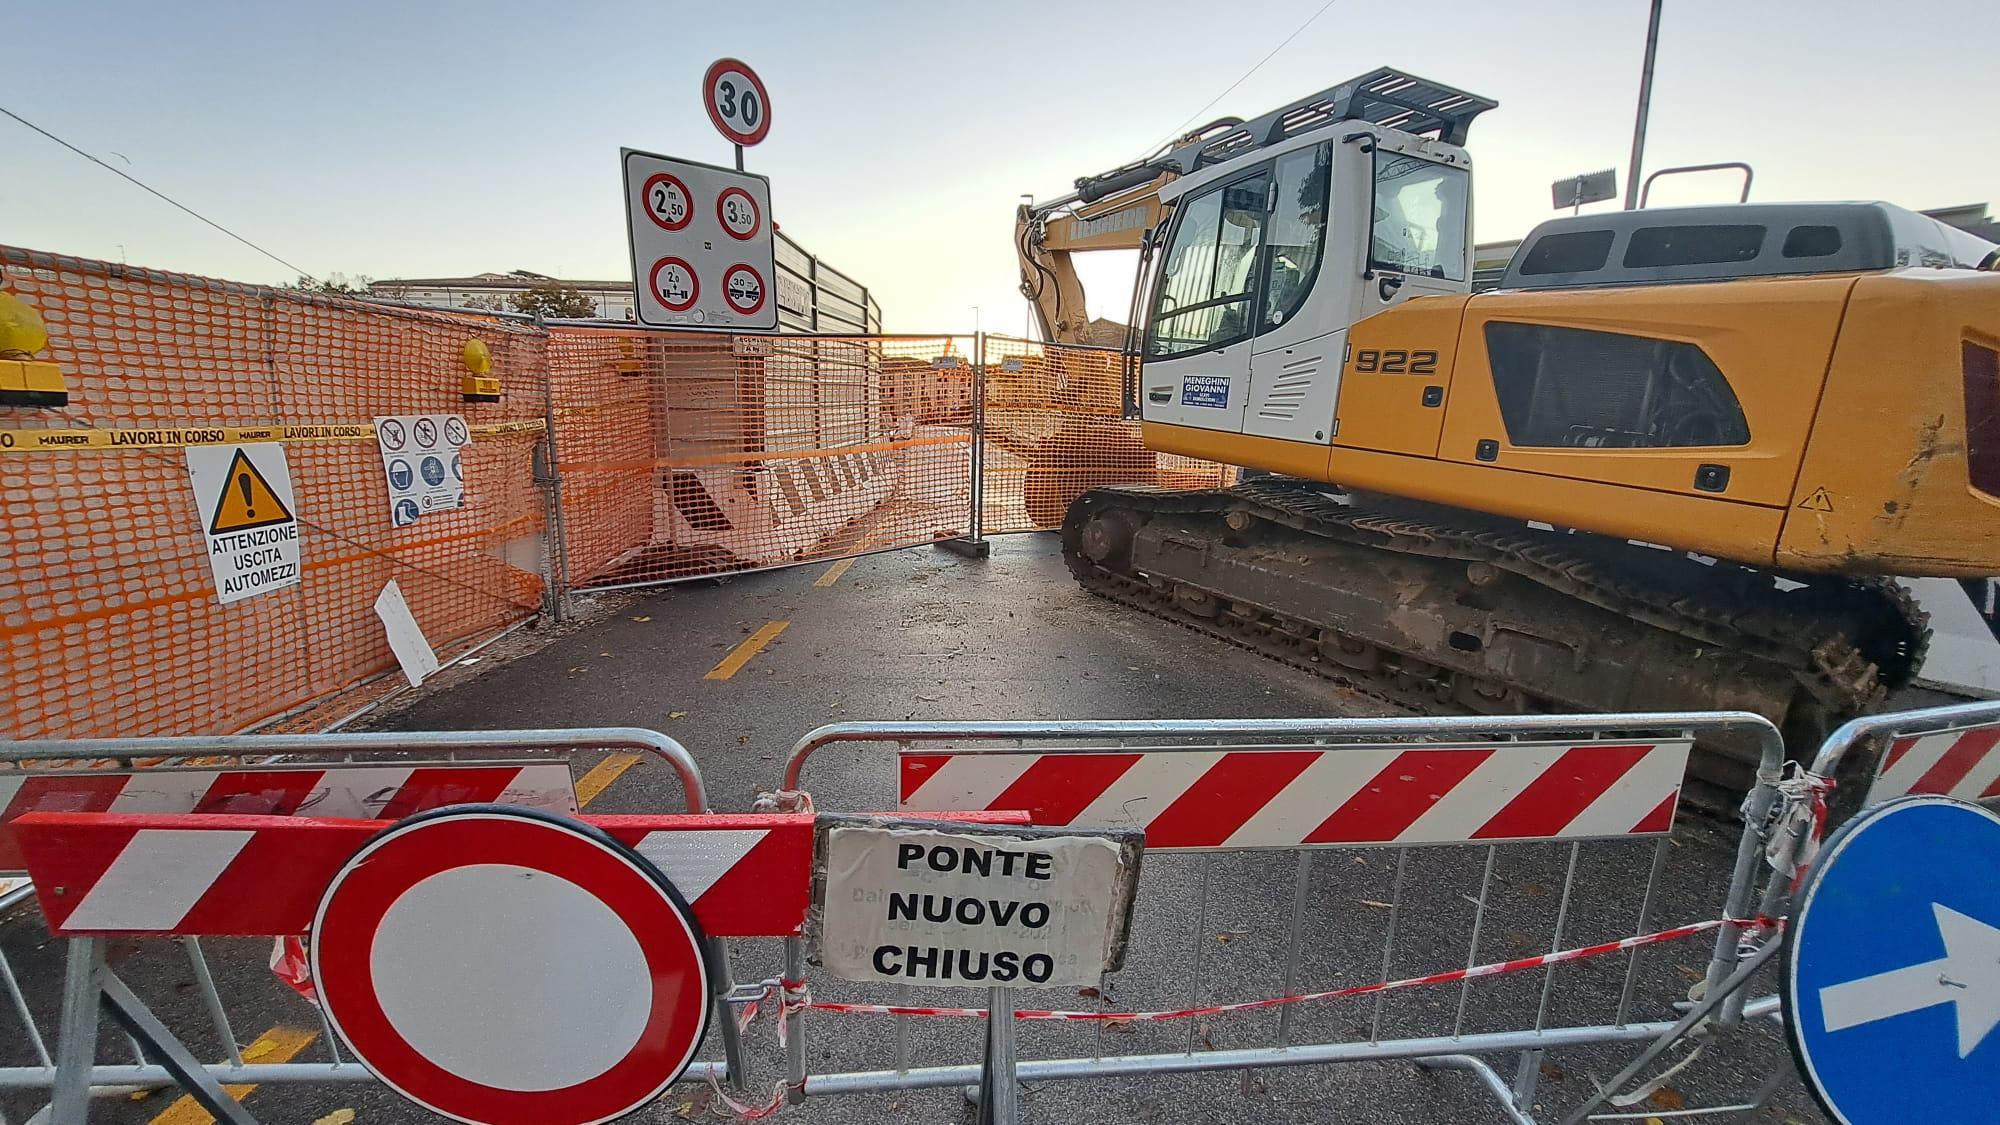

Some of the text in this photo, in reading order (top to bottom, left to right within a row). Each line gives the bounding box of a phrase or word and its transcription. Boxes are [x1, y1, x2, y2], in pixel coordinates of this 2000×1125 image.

[719, 80, 759, 127] 30
[733, 278, 745, 287] 30
[1355, 349, 1438, 376] 922
[1184, 376, 1230, 386] MENEGHINI
[1185, 384, 1226, 394] GIOVANNI
[39, 435, 89, 445] MAURER
[110, 431, 162, 446] LAVORI
[167, 430, 182, 444] IN
[185, 430, 225, 443] CORSO
[239, 431, 271, 439] MAURER
[284, 427, 318, 439] LAVORI
[321, 427, 332, 438] IN
[333, 426, 361, 437] CORSO
[212, 525, 297, 555] ATTENZIONE
[233, 547, 283, 570] USCITA
[224, 562, 297, 595] AUTOMEZZI
[897, 843, 1053, 880] PONTE
[887, 892, 1050, 929] NUOVO
[872, 944, 1055, 984] CHIUSO
